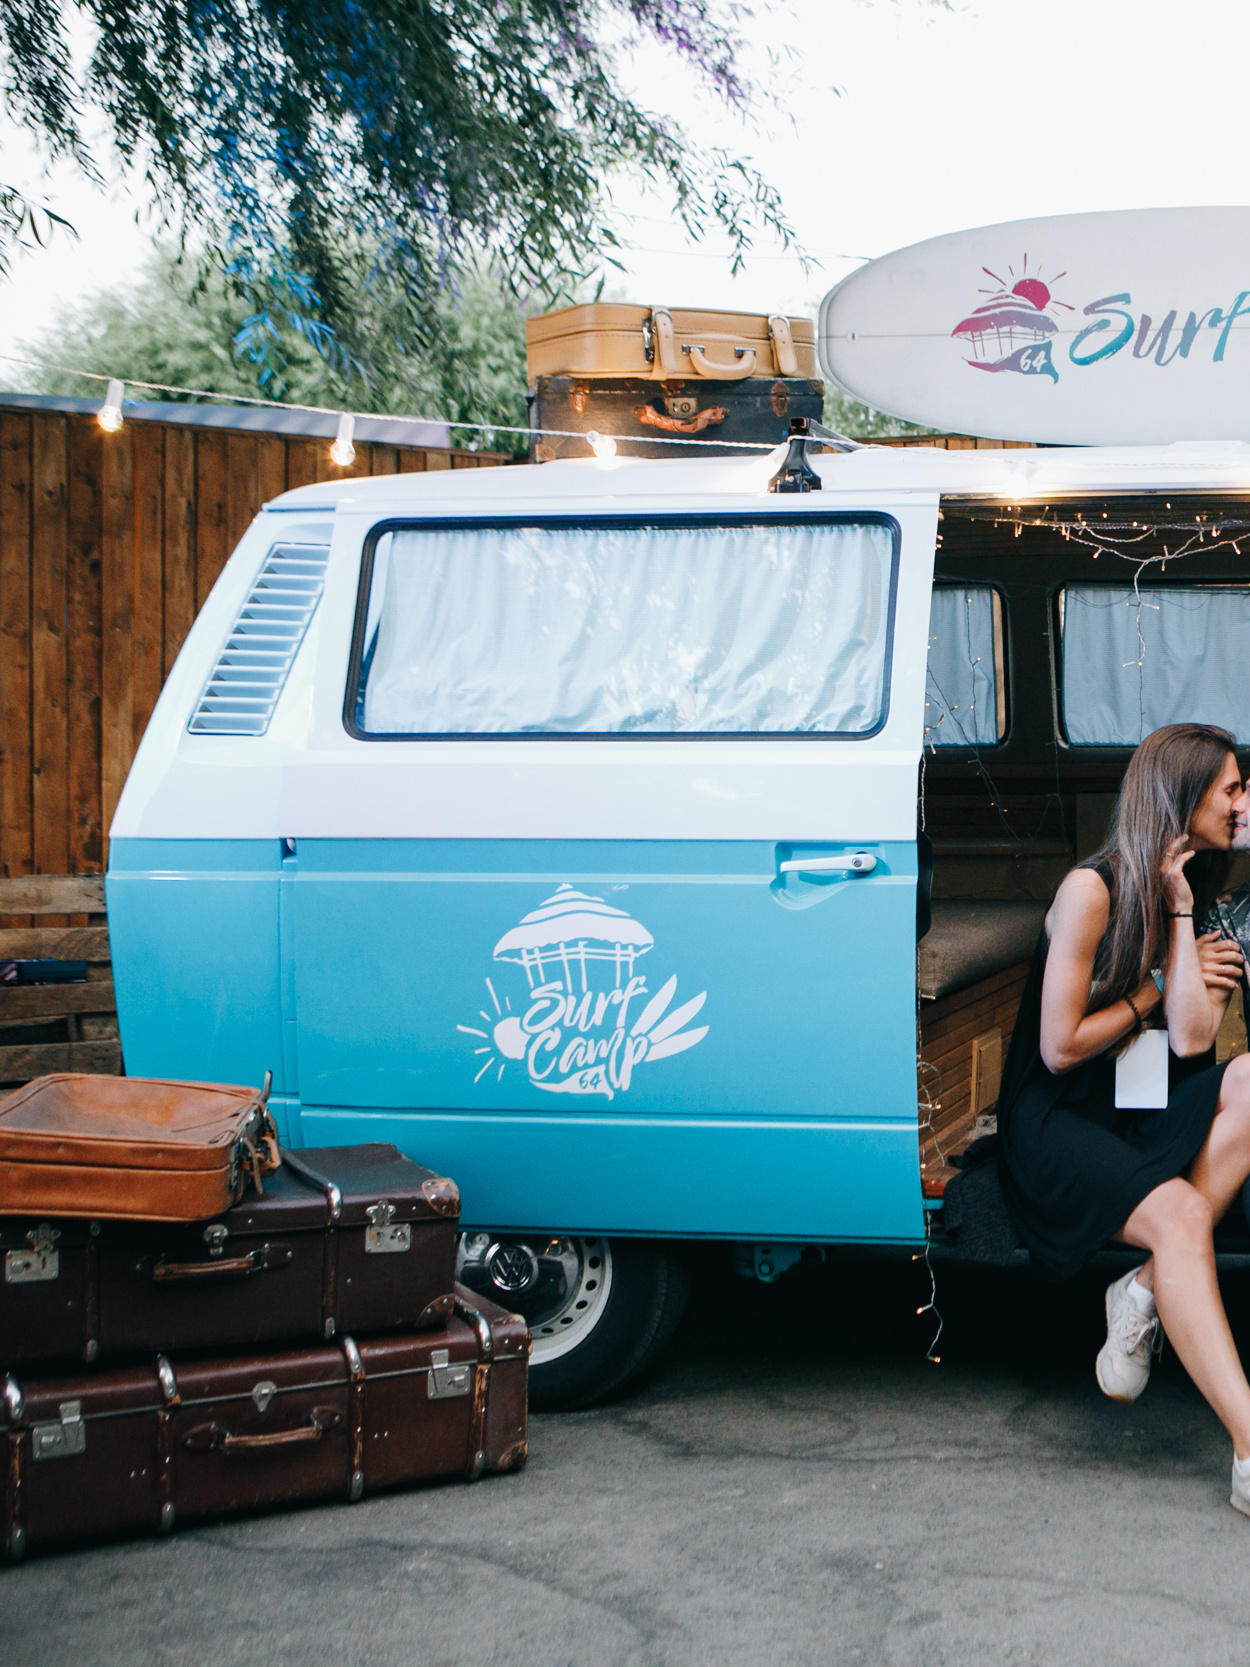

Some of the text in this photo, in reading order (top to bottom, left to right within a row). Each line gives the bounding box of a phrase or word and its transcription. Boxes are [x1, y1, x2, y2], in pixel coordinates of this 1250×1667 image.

[1020, 351, 1048, 373] 64
[523, 976, 648, 1034] Surf
[528, 1027, 648, 1091] Camp
[579, 1071, 602, 1089] 64
